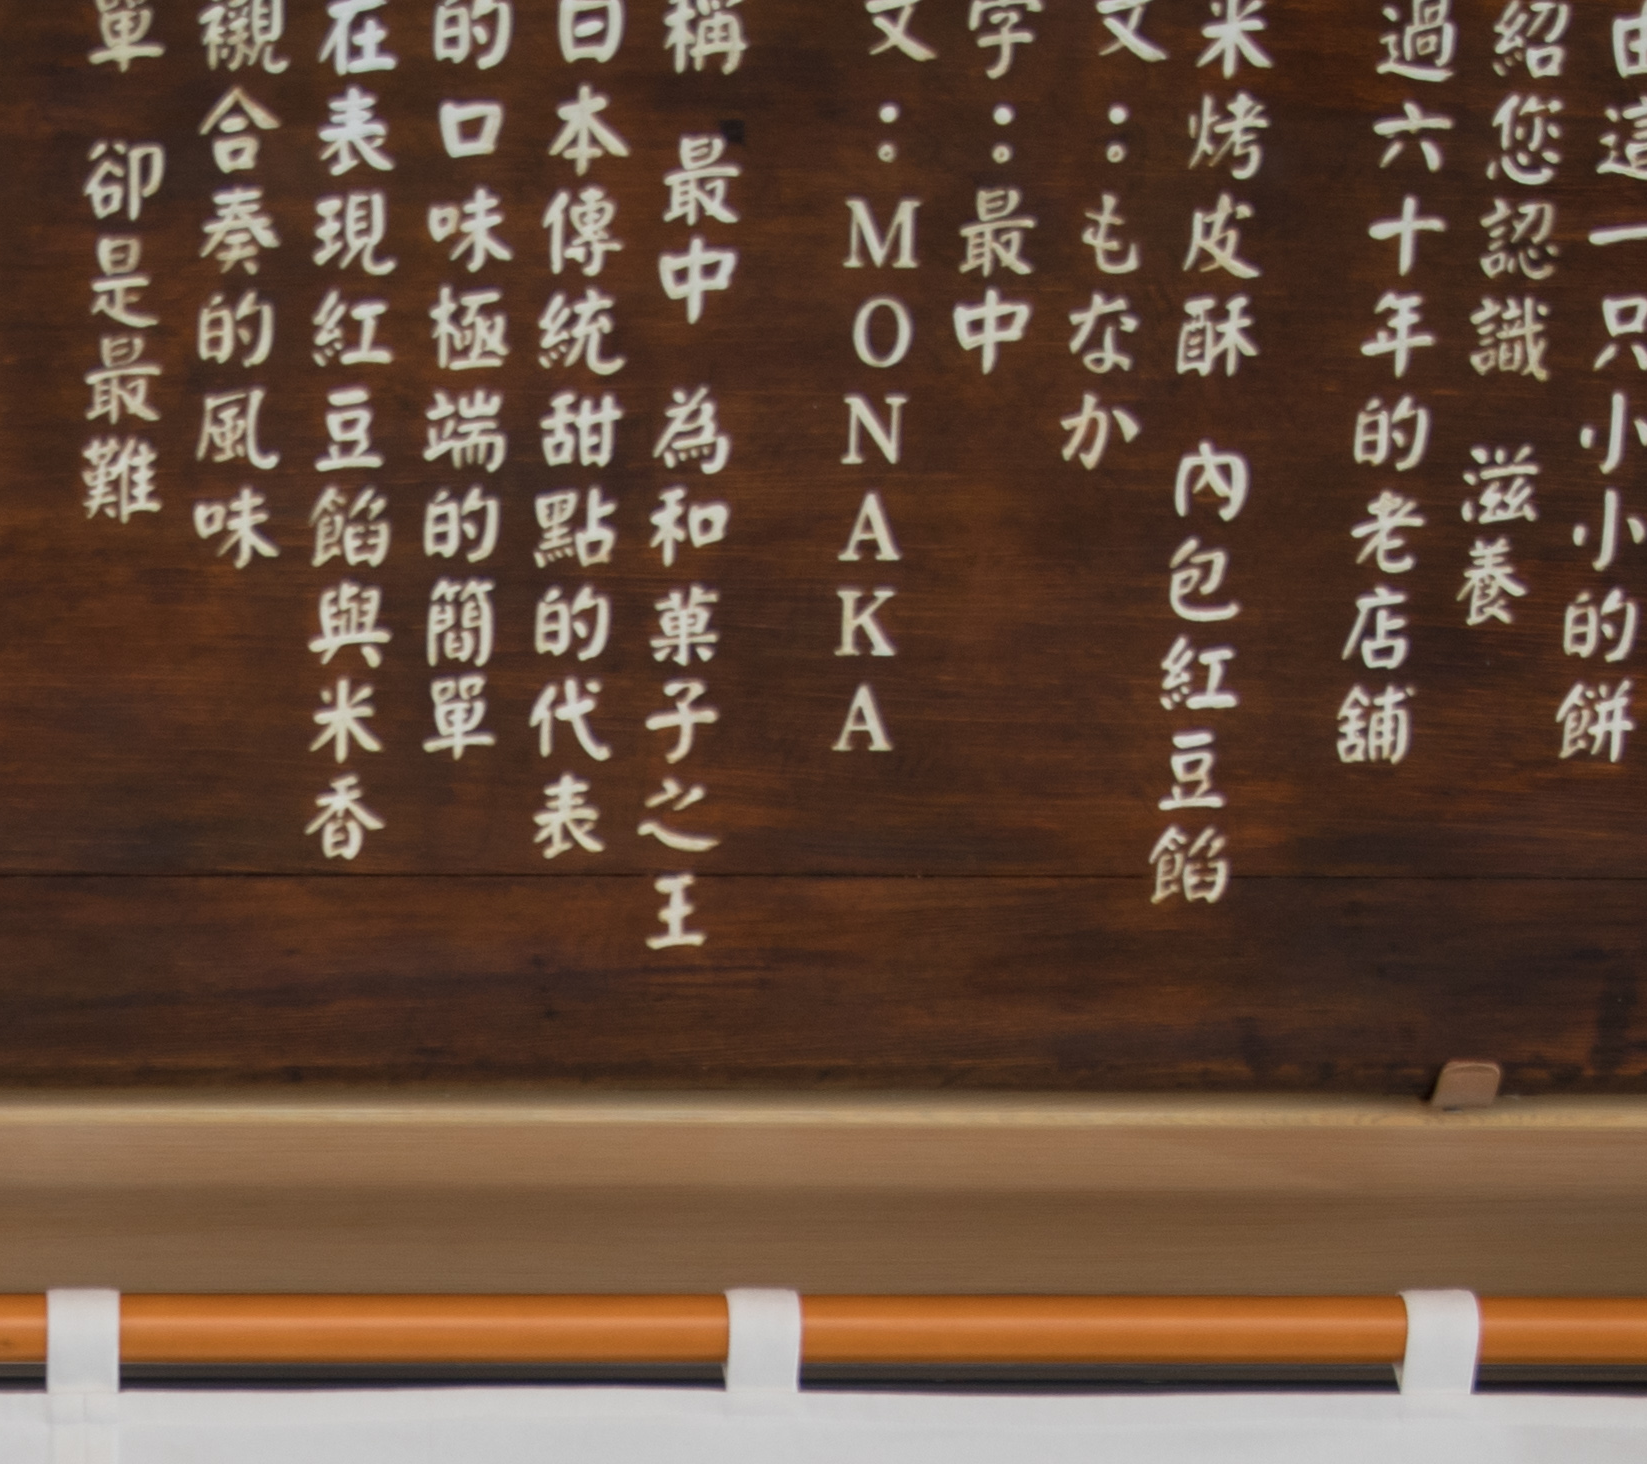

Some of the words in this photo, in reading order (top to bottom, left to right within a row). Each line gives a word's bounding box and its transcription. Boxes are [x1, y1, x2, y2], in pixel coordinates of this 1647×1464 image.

[82, 143, 164, 523] 卻是最難
[194, 0, 288, 568] 襯合奏的風味
[659, 136, 740, 324] 最中
[1177, 0, 1271, 376] 米烤皮酥
[1470, 0, 1567, 380] 紹您認識
[638, 387, 730, 949] 為和菓子之王
[1149, 441, 1248, 903] 內包紅豆餡
[1457, 446, 1538, 625] 滋養
